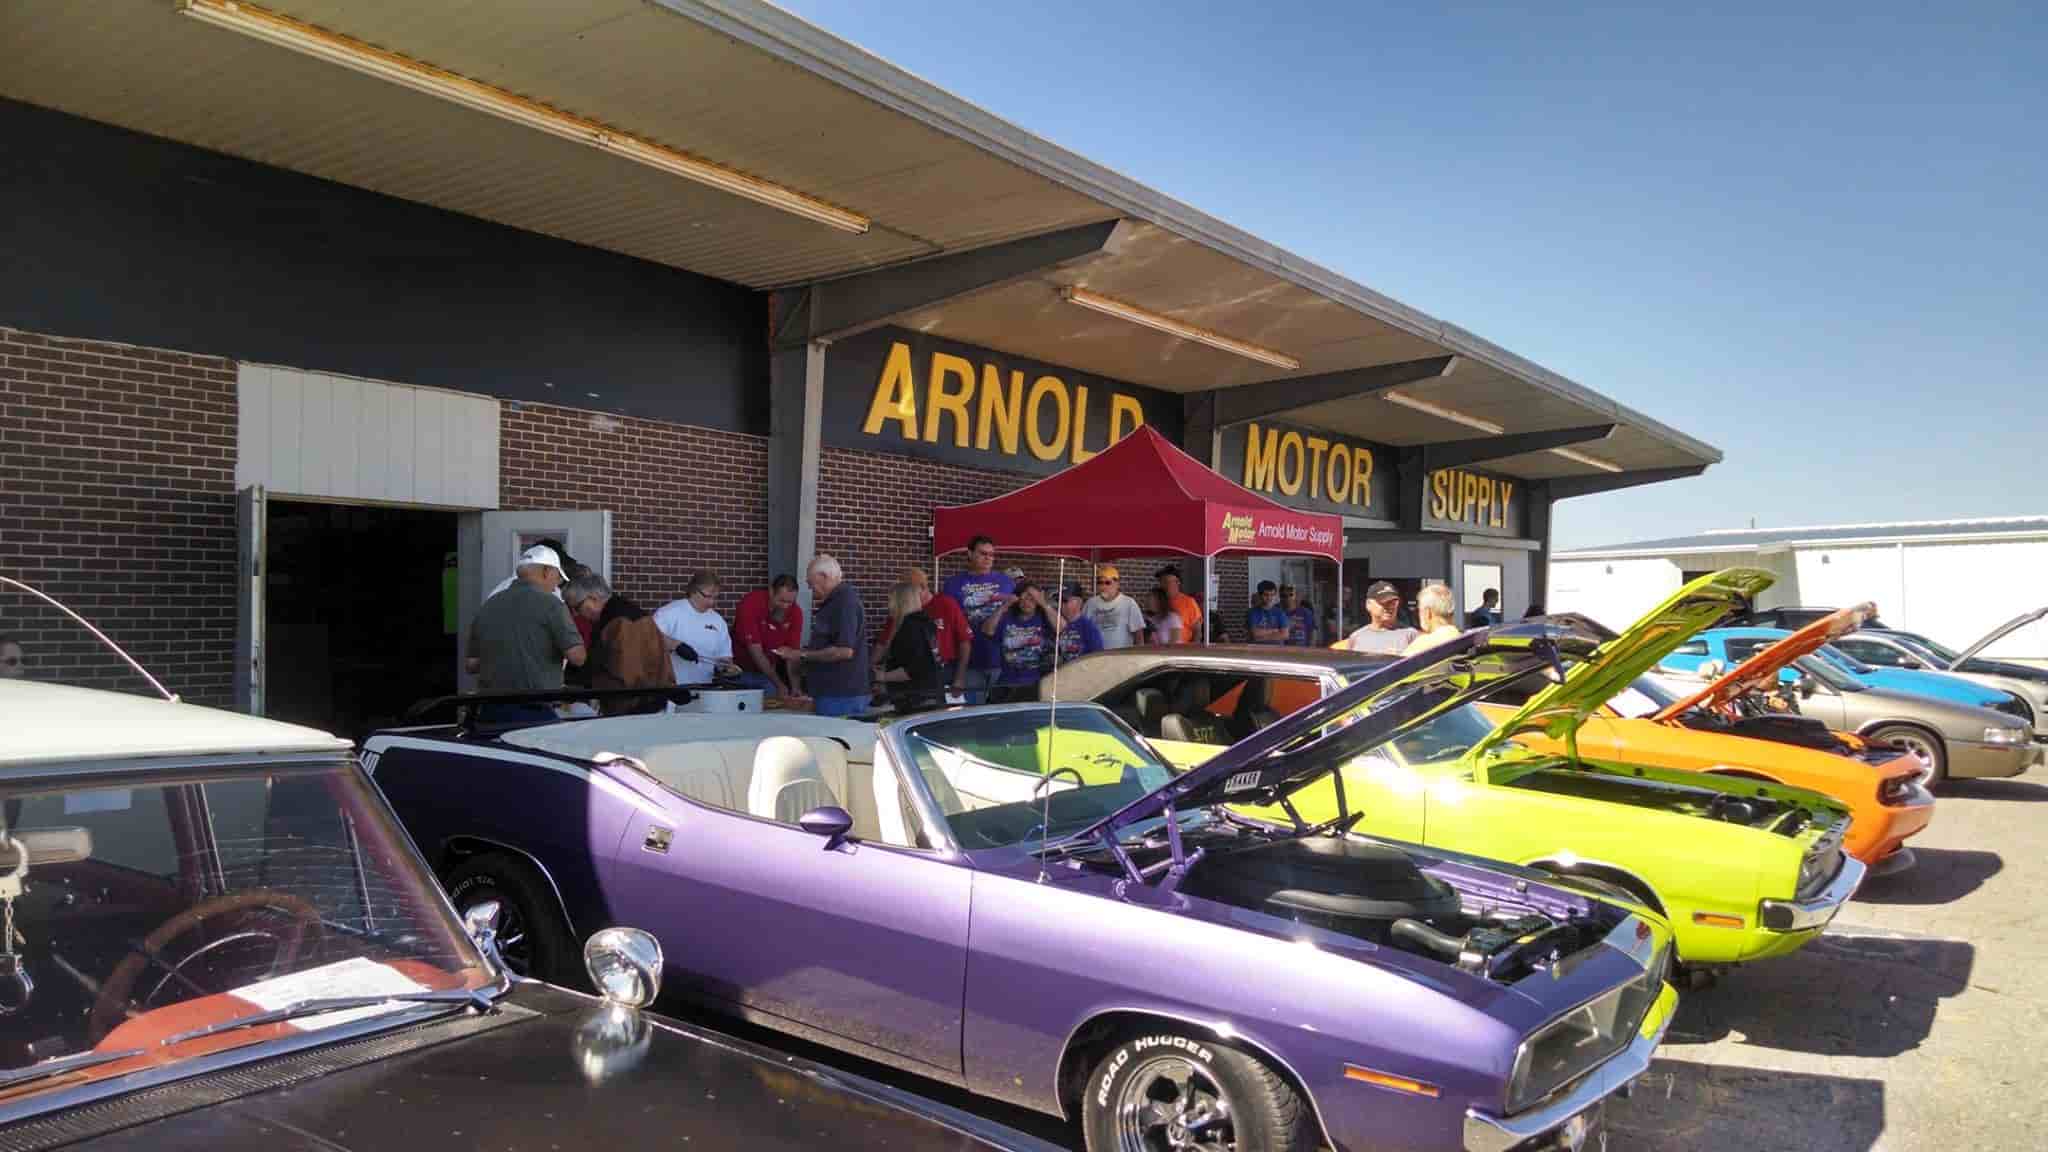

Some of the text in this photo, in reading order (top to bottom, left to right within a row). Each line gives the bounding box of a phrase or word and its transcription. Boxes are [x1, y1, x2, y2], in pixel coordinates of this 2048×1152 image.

[863, 341, 1512, 529] ARNOLD MOTOR SUPPLY
[1222, 512, 1253, 529] Arnold
[1227, 528, 1256, 544] Motor
[1258, 522, 1335, 546] Arnold Motor Supply
[1097, 1035, 1214, 1107] ROAD HUGGER
